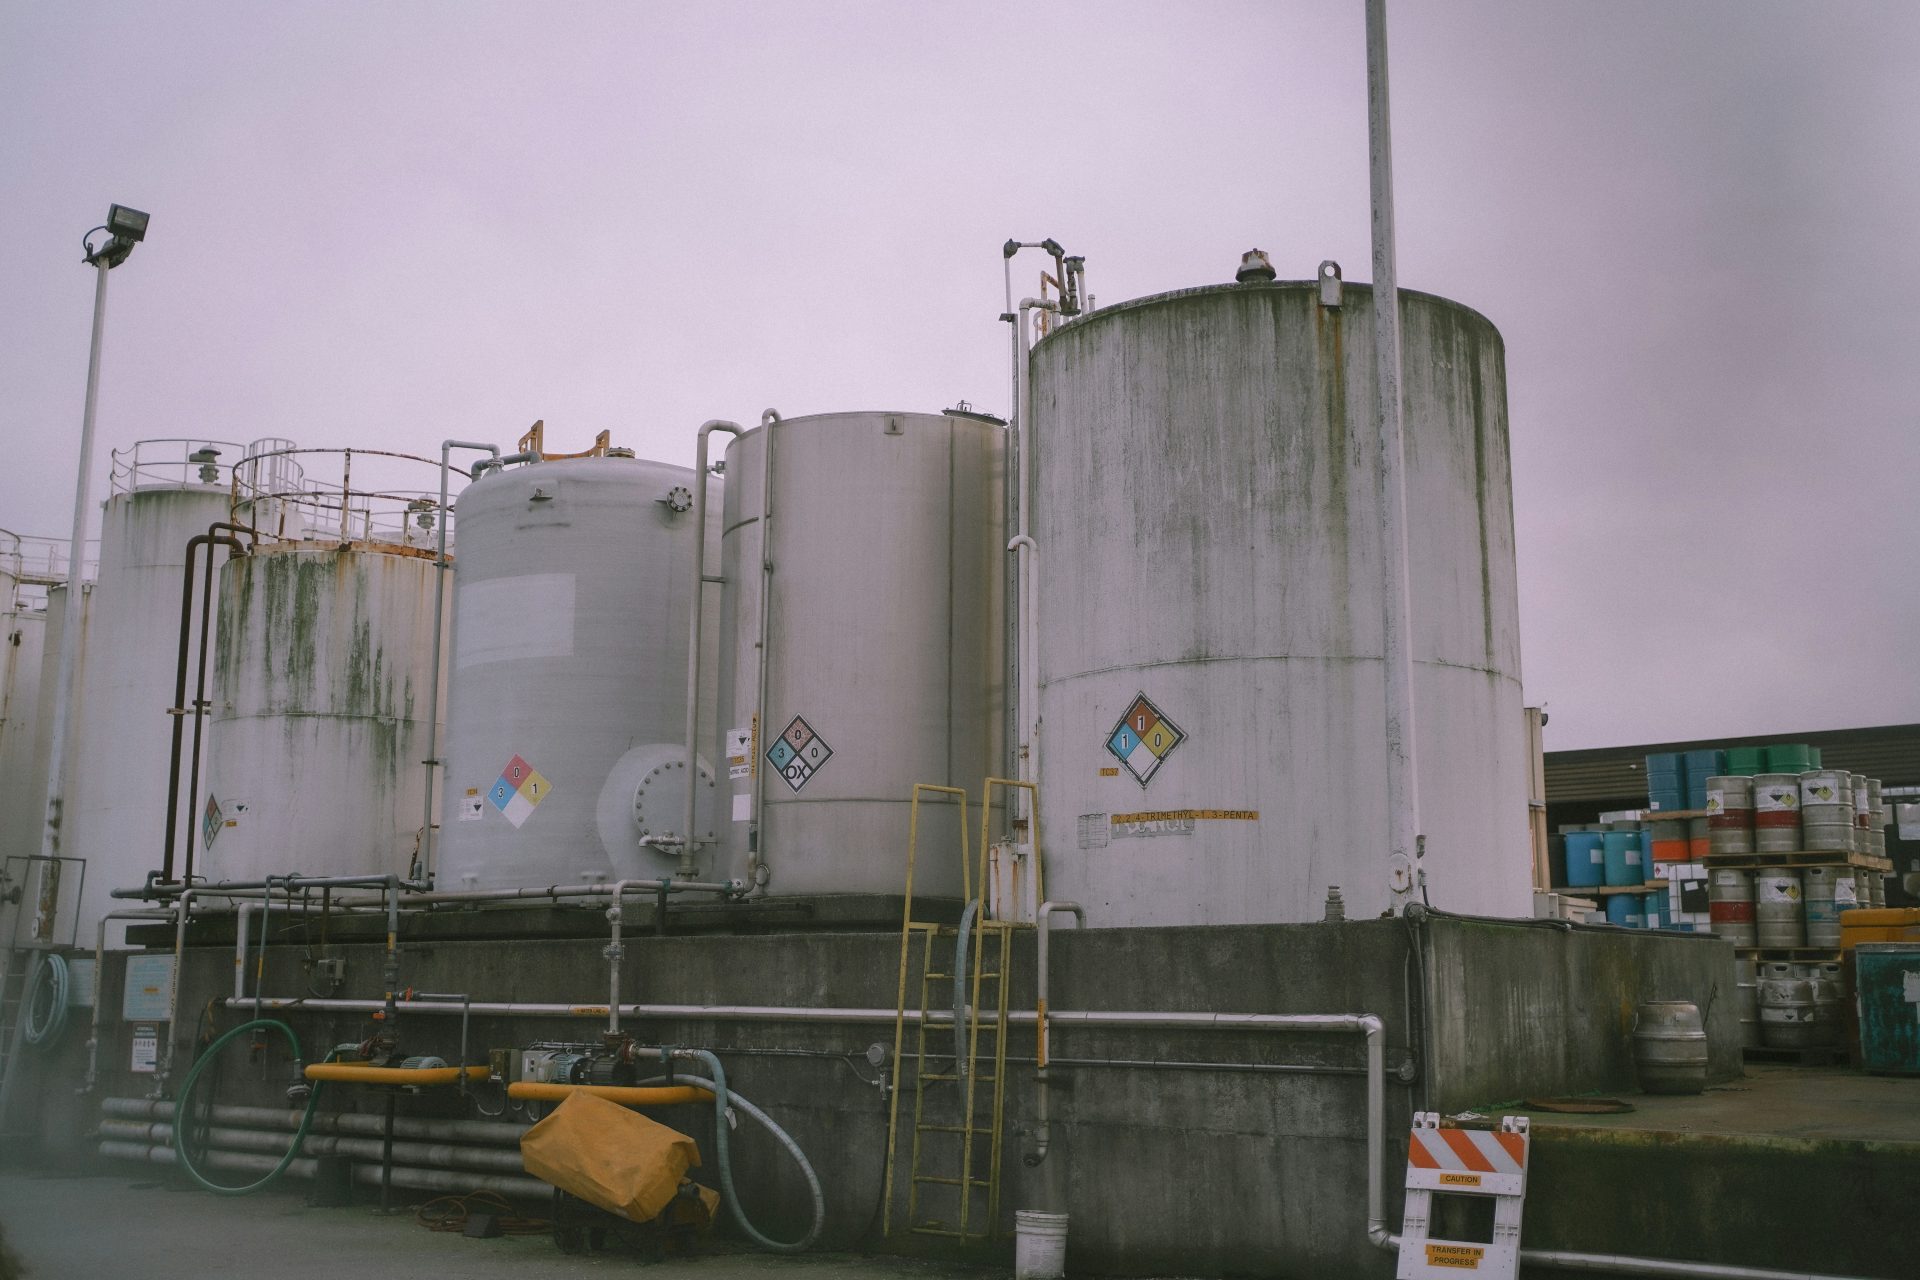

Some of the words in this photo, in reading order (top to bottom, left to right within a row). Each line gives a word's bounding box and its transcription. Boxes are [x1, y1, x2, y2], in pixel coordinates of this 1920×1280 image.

[1138, 716, 1144, 730] 1
[795, 730, 801, 740] 0
[1154, 733, 1161, 747] 0
[1122, 734, 1129, 748] 1
[778, 748, 785, 758] 3
[811, 747, 818, 758] 0
[514, 767, 519, 778] 0
[786, 765, 807, 779] OX
[498, 787, 504, 797] 3
[532, 783, 537, 793] 1
[1445, 1175, 1478, 1184] CAUTION
[1431, 1246, 1471, 1256] TRANSFER
[1473, 1248, 1482, 1256] IN
[1434, 1256, 1475, 1266] PROGRESS
